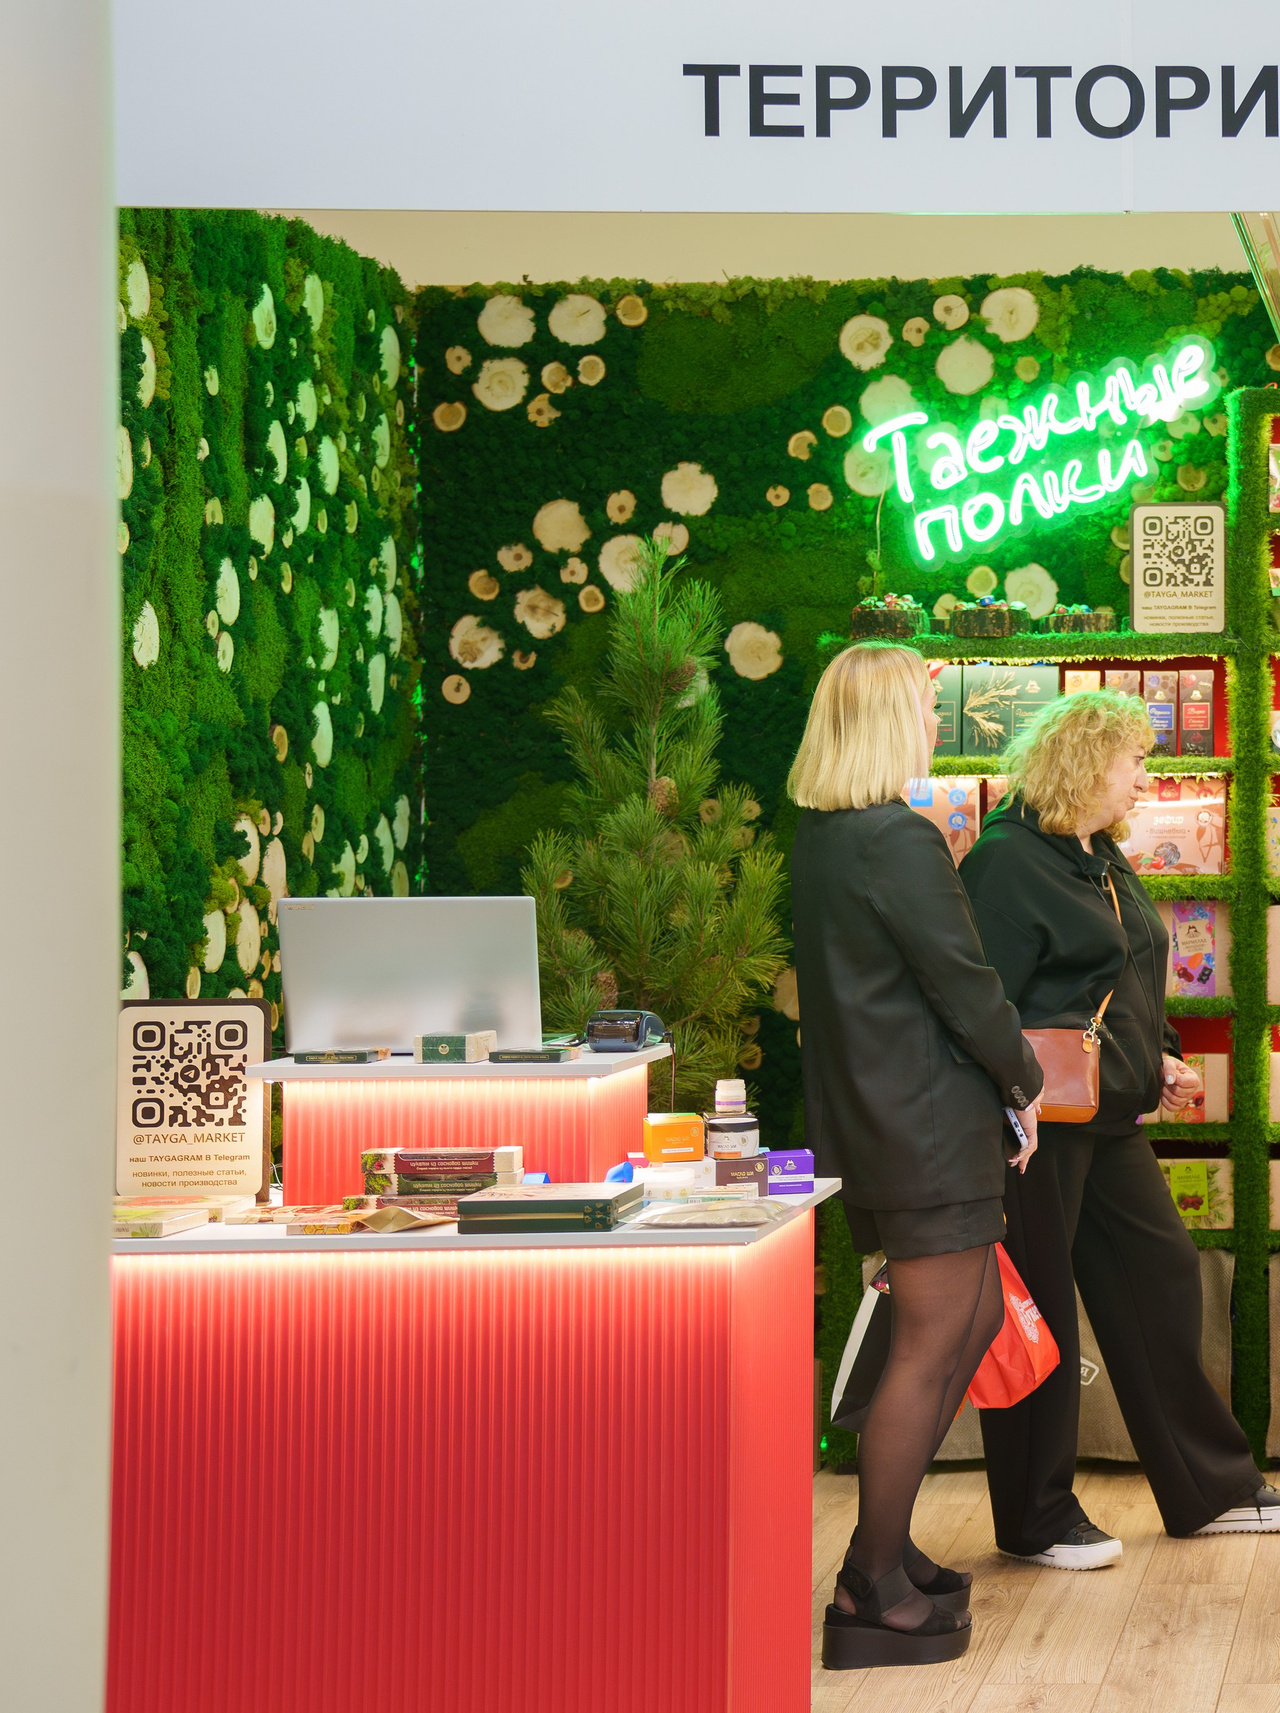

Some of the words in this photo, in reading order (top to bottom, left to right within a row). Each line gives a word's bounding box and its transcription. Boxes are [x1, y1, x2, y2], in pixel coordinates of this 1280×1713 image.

[863, 344, 1211, 503] Таежные
[913, 438, 1149, 561] полки
[1143, 590, 1214, 600] @TAYGA_MARKET
[132, 1132, 246, 1146] @TAYGA_MARKET
[149, 1154, 203, 1162] TAYGAGRAM
[214, 1153, 250, 1163] Telegram
[132, 1171, 170, 1179] новинки,
[172, 1169, 214, 1177] полезные
[216, 1168, 247, 1177] статьи,
[141, 1180, 177, 1188] новости
[178, 1179, 238, 1188] производства
